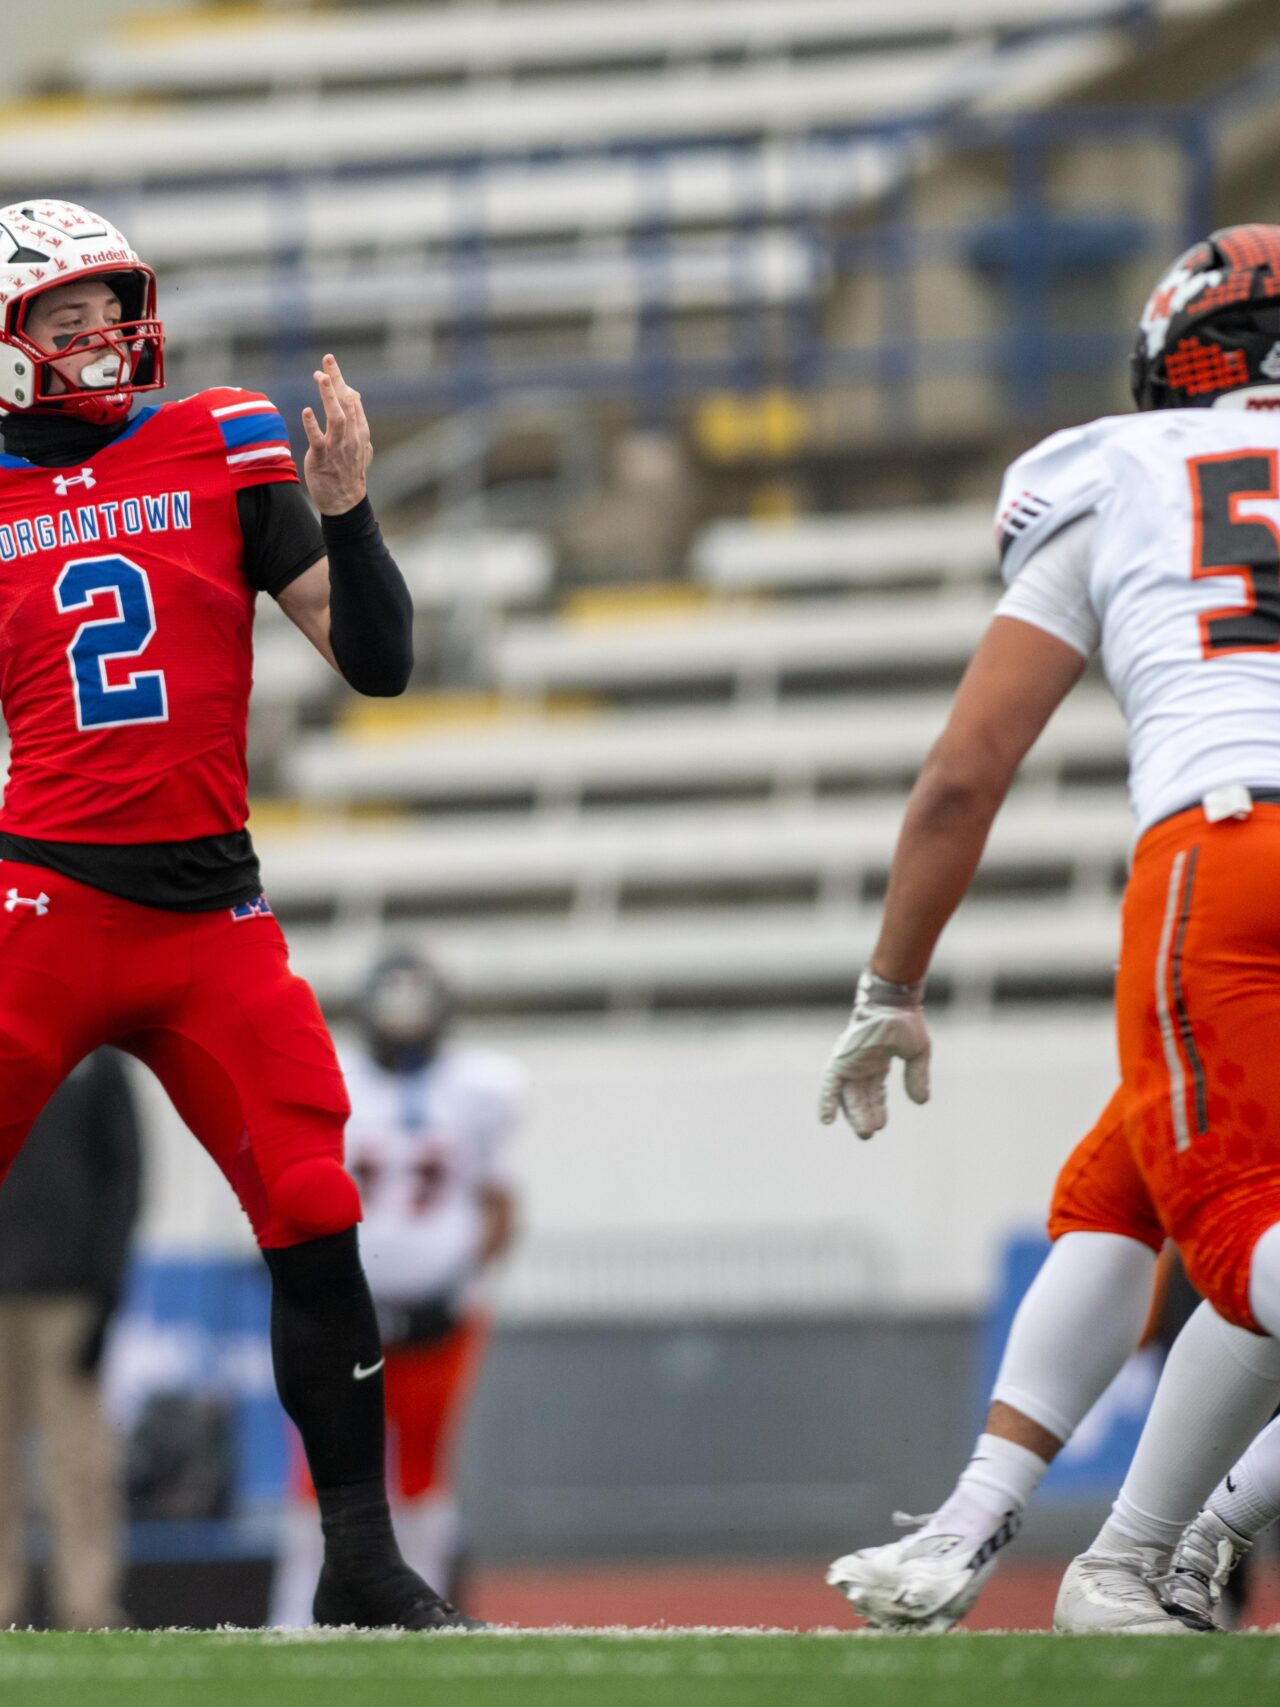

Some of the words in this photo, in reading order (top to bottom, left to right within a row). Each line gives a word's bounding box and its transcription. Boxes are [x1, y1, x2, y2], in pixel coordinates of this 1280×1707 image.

[80, 249, 129, 265] Riddell
[53, 553, 169, 732] 2
[1185, 447, 1280, 662] 5
